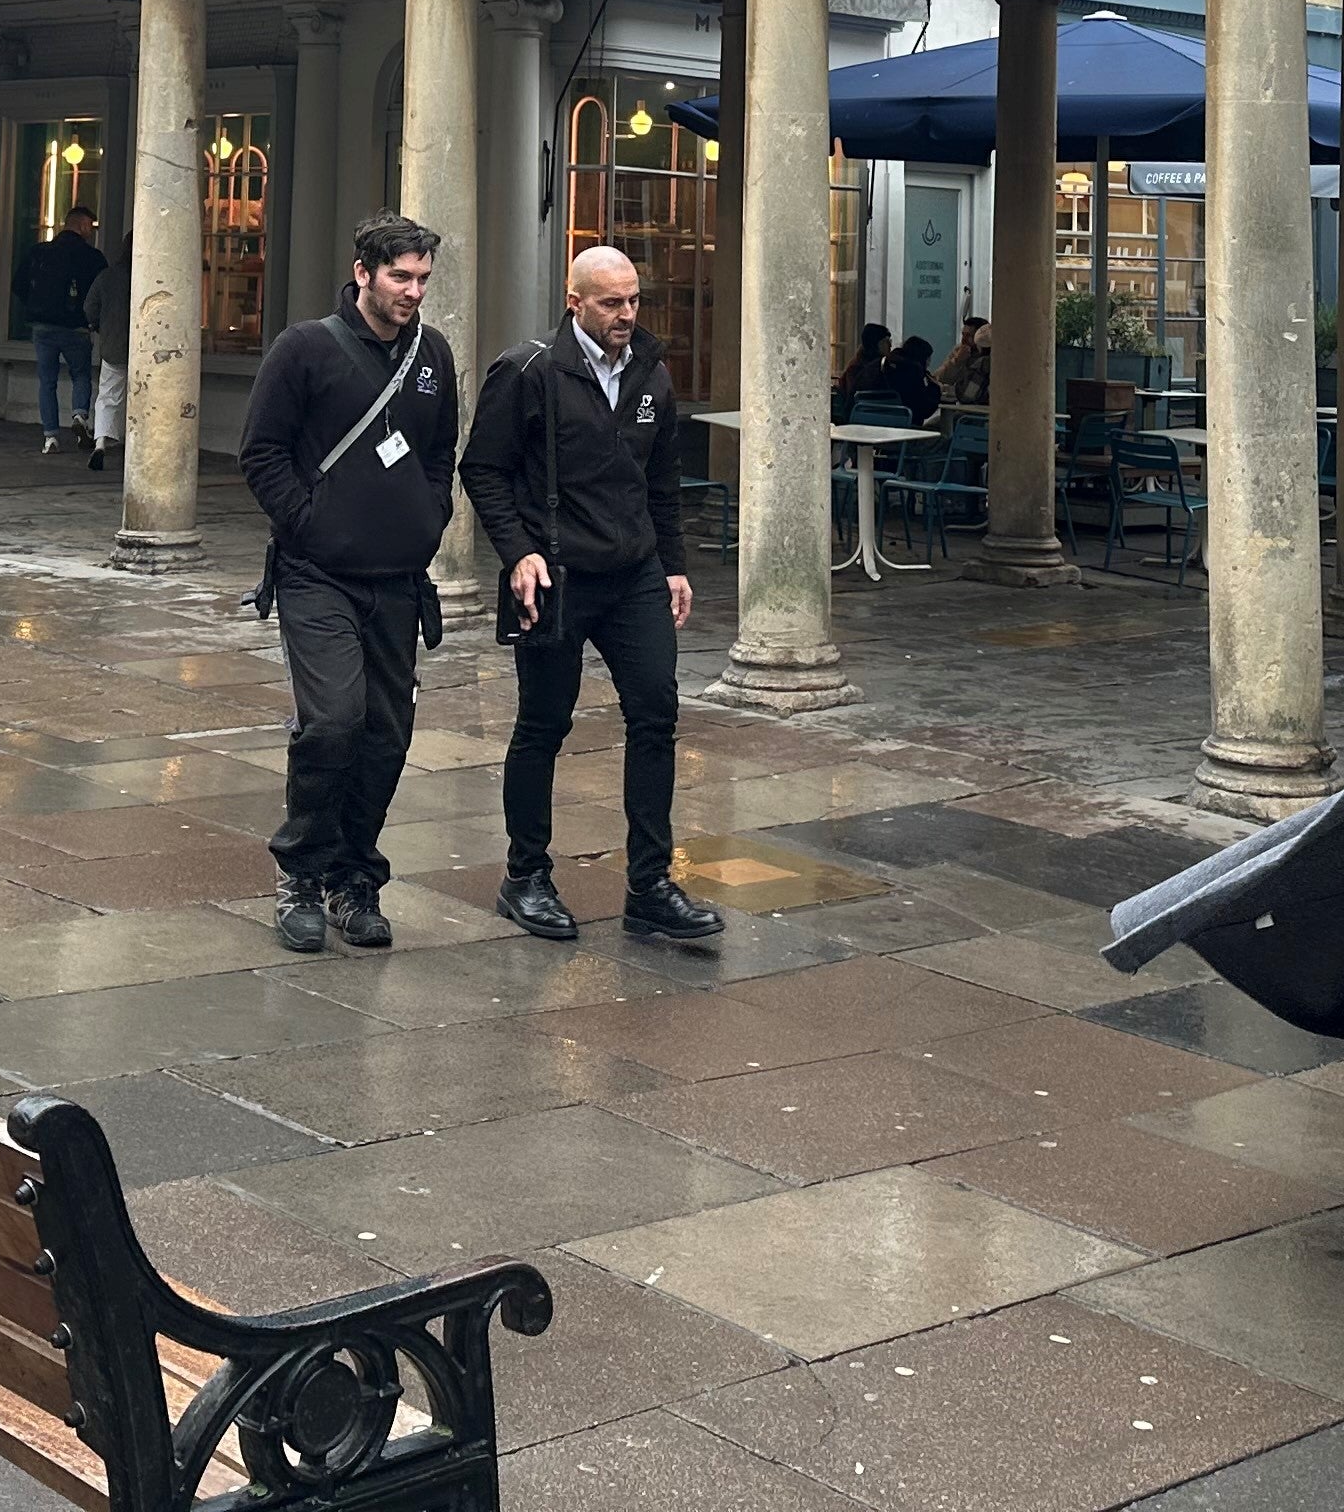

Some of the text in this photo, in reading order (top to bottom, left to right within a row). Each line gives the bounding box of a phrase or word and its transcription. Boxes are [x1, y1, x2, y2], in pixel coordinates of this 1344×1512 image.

[1146, 172, 1183, 185] COFFEE
[1184, 173, 1191, 184] &
[636, 406, 656, 419] SMS
